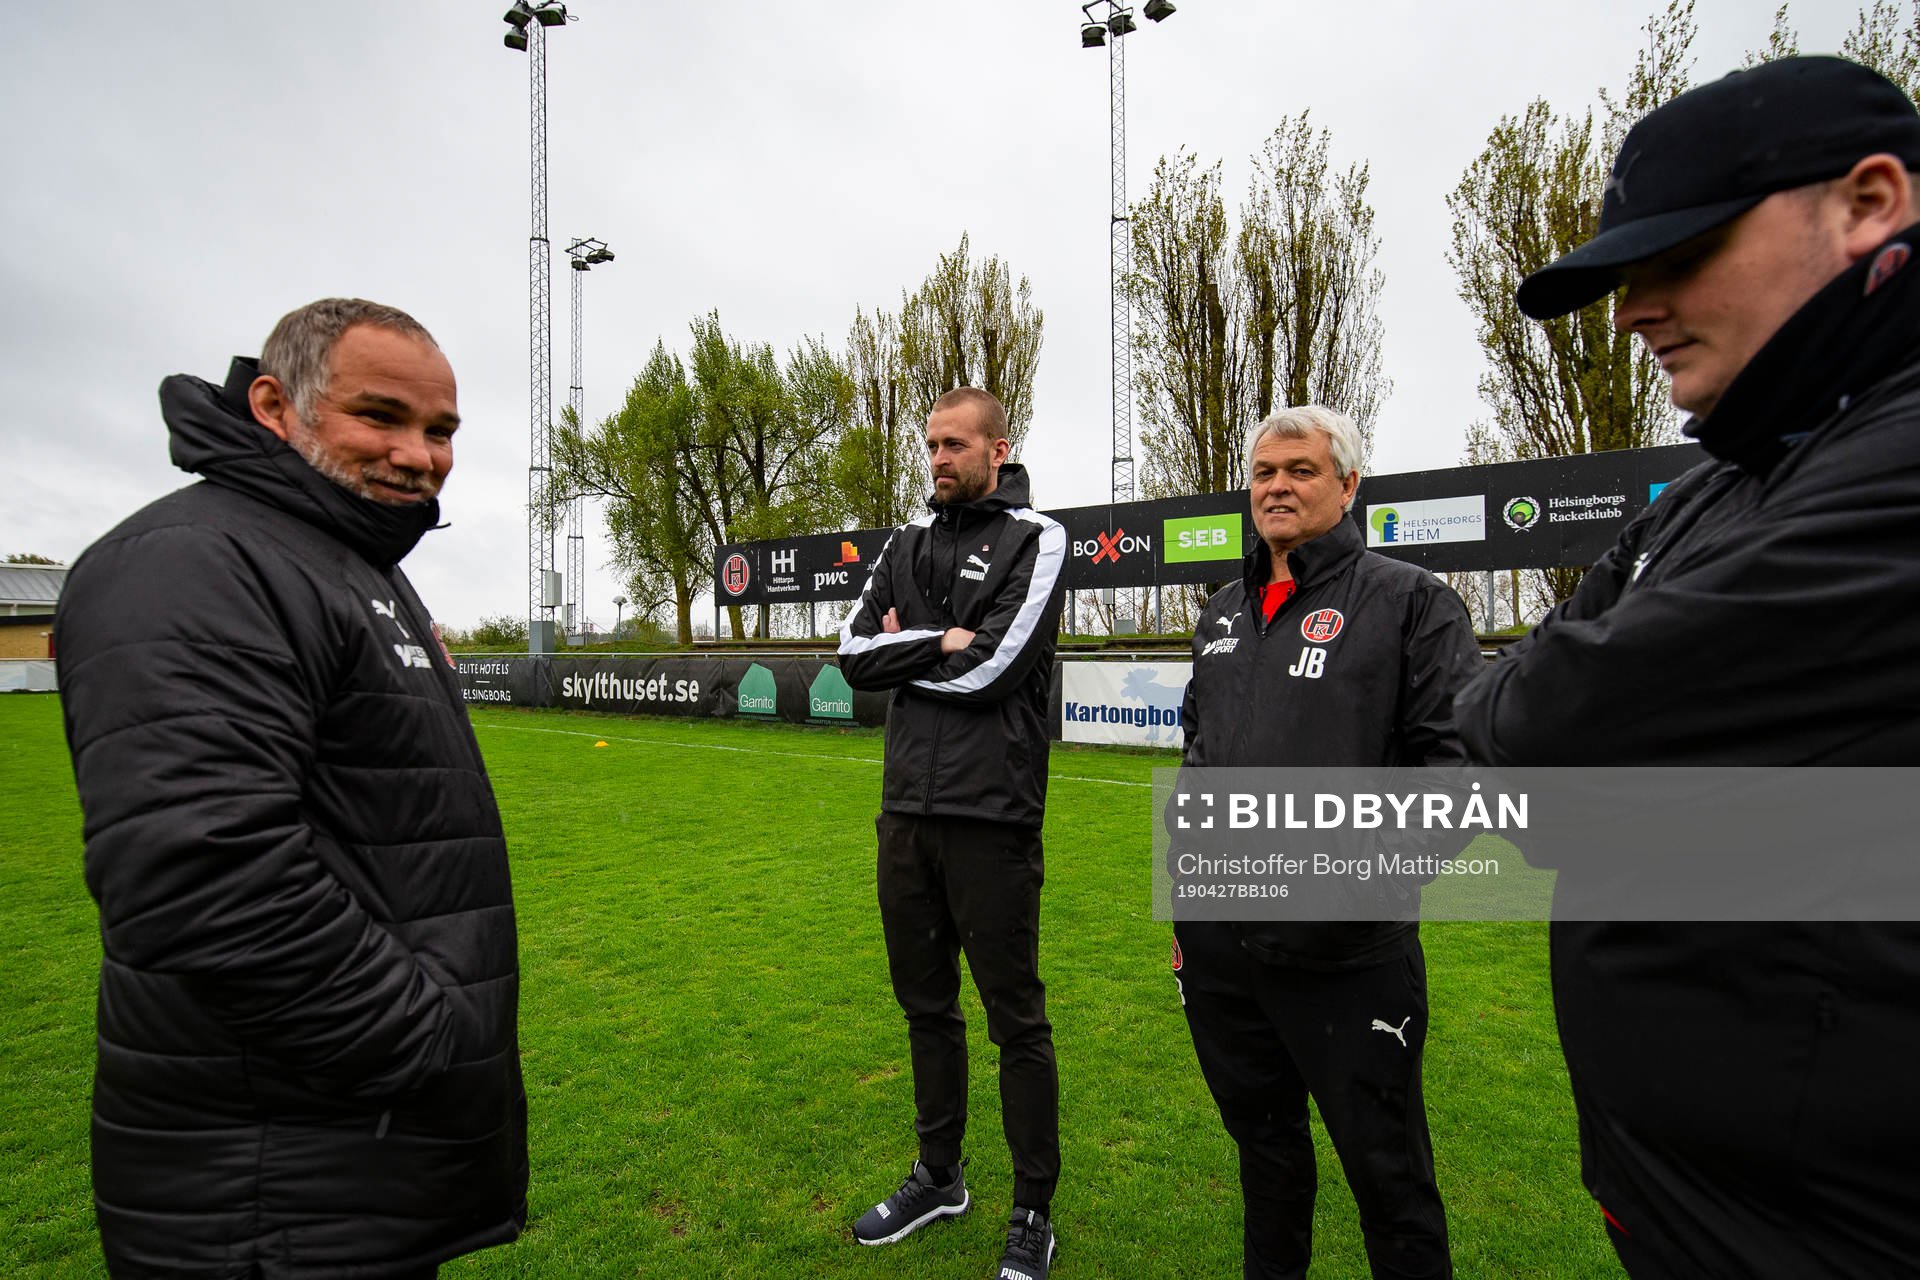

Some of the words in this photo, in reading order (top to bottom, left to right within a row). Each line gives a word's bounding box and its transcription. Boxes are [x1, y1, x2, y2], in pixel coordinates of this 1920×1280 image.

[1549, 494, 1626, 509] Helsingborgs
[1403, 514, 1482, 528] HELSINGBORGS
[1549, 508, 1622, 523] Racketklubb
[1178, 527, 1227, 549] SEB
[1403, 528, 1440, 542] HEM
[1073, 527, 1150, 565] BOXON
[814, 571, 849, 591] pwc
[960, 569, 985, 581] PUMA
[459, 663, 479, 674] ELITE
[480, 663, 509, 675] HOTELS
[1288, 647, 1327, 679] JB
[461, 688, 511, 701] ELSINGBORG
[562, 671, 699, 704] skylthuset.se
[739, 694, 774, 709] Garnito
[811, 697, 850, 713] Garnito
